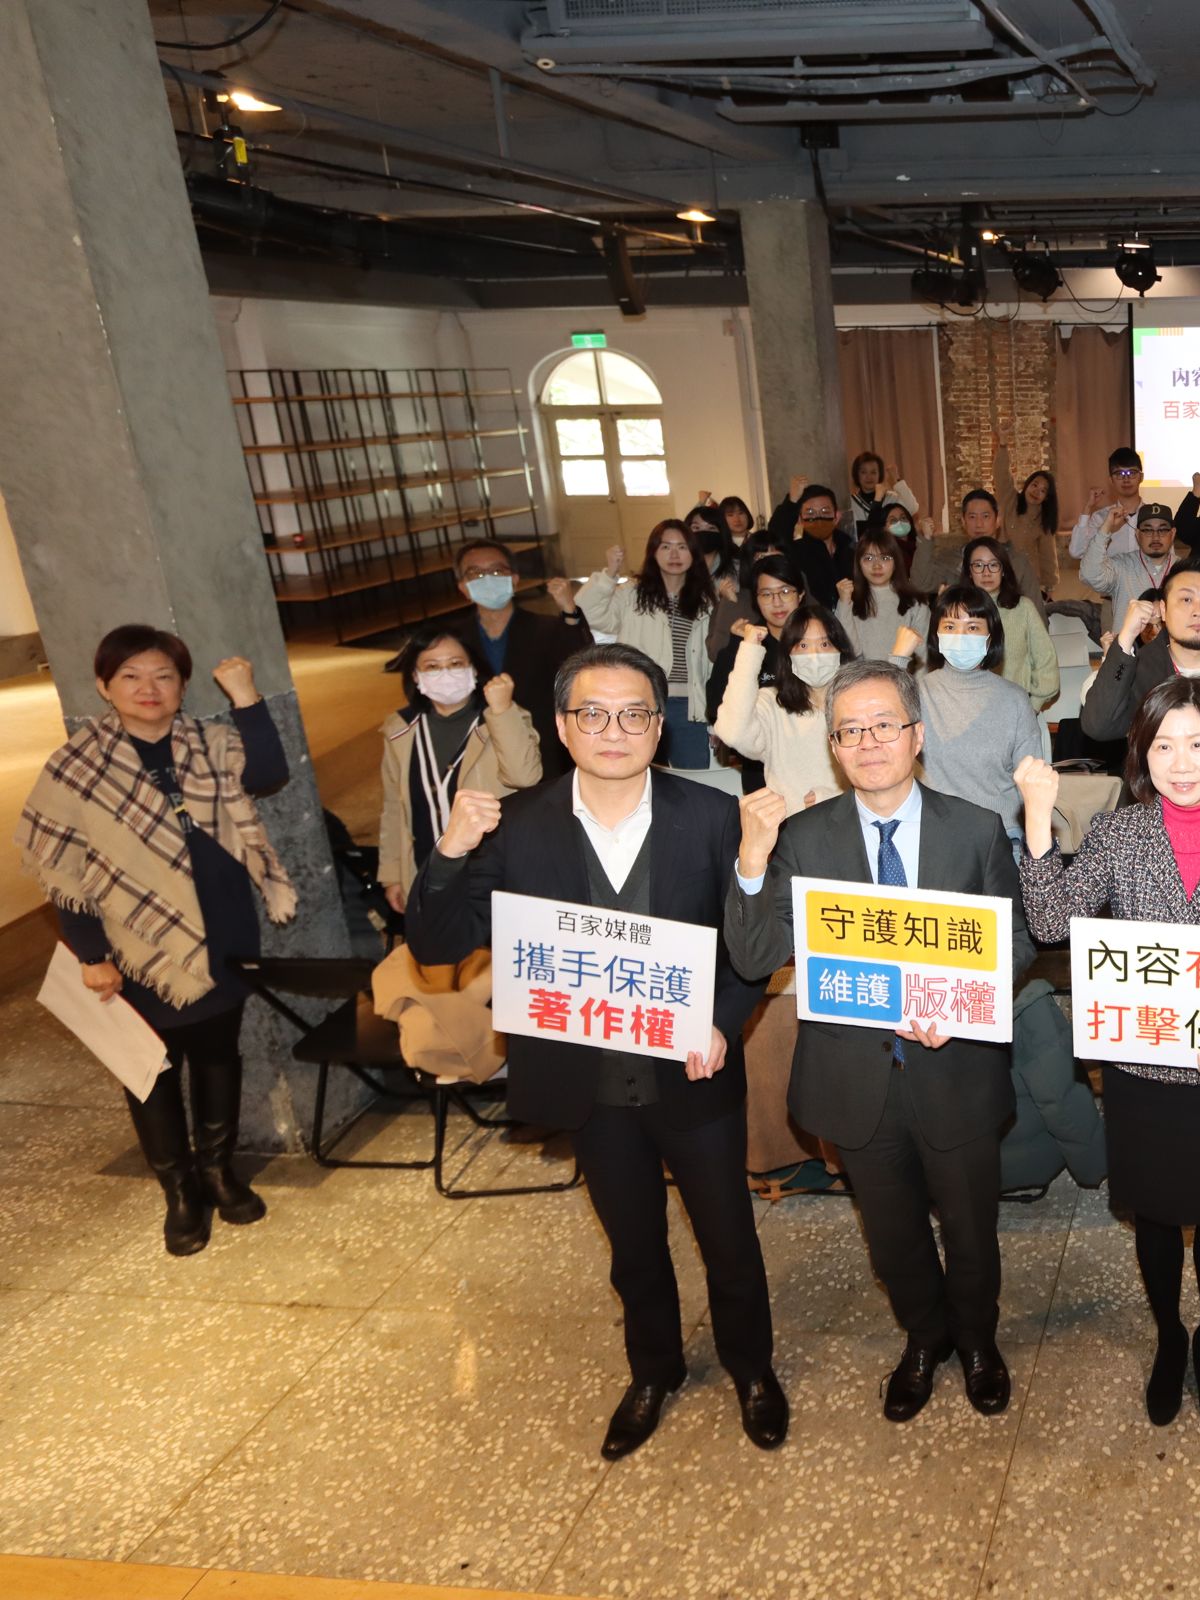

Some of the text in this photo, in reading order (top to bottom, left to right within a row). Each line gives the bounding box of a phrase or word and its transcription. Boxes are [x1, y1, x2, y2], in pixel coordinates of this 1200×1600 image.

[1152, 505, 1161, 515] D
[556, 910, 652, 946] 百家媒體
[820, 904, 983, 954] 守護知識
[513, 939, 693, 1007] 攜手保護
[819, 968, 996, 1025] 維護 版權
[528, 988, 675, 1049] 著作權
